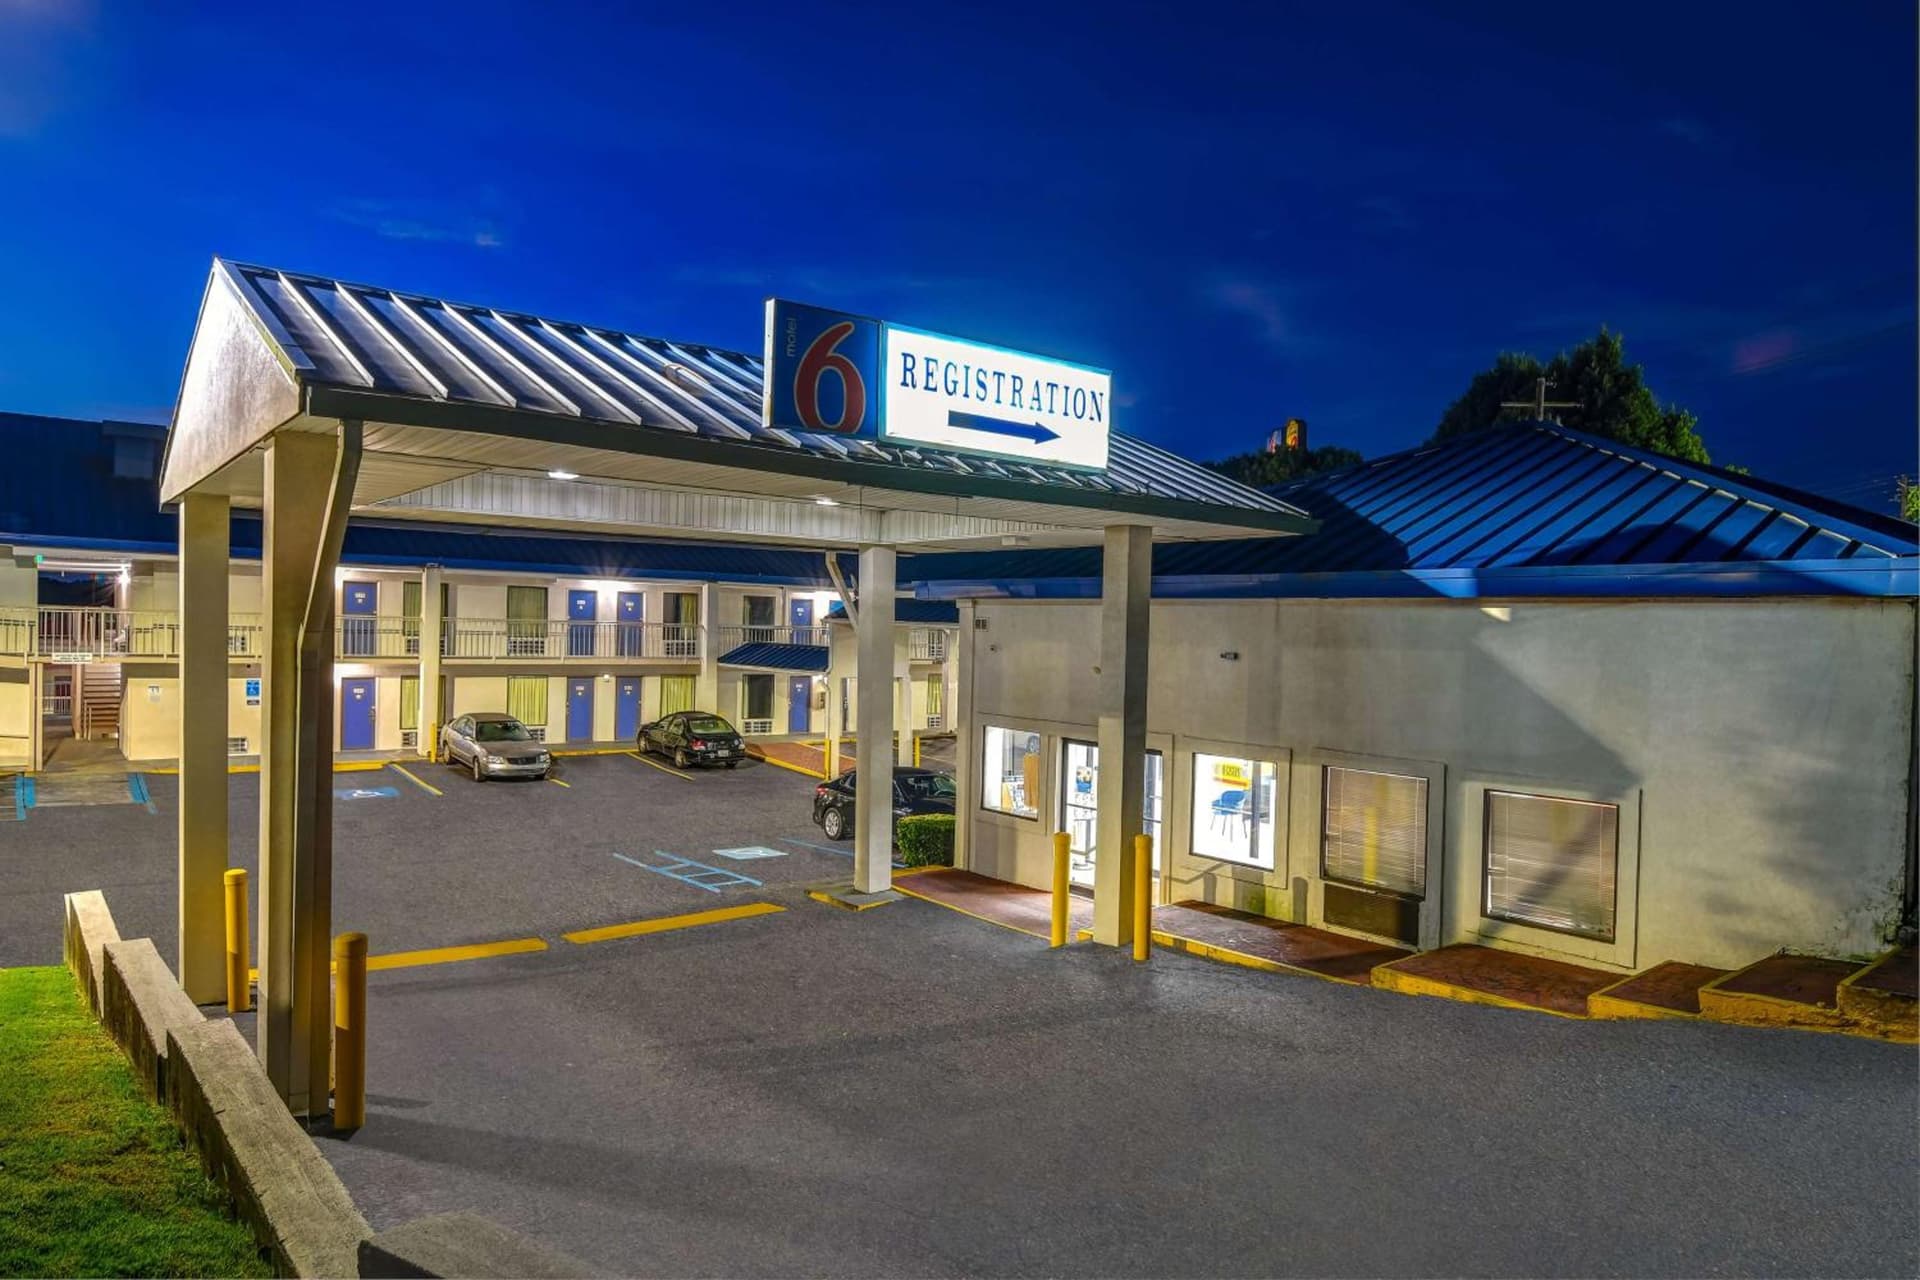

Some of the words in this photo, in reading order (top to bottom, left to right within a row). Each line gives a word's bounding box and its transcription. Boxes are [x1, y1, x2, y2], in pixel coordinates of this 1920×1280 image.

[786, 318, 797, 357] motel
[793, 321, 866, 433] 6
[900, 352, 1105, 422] REGISTRATION
